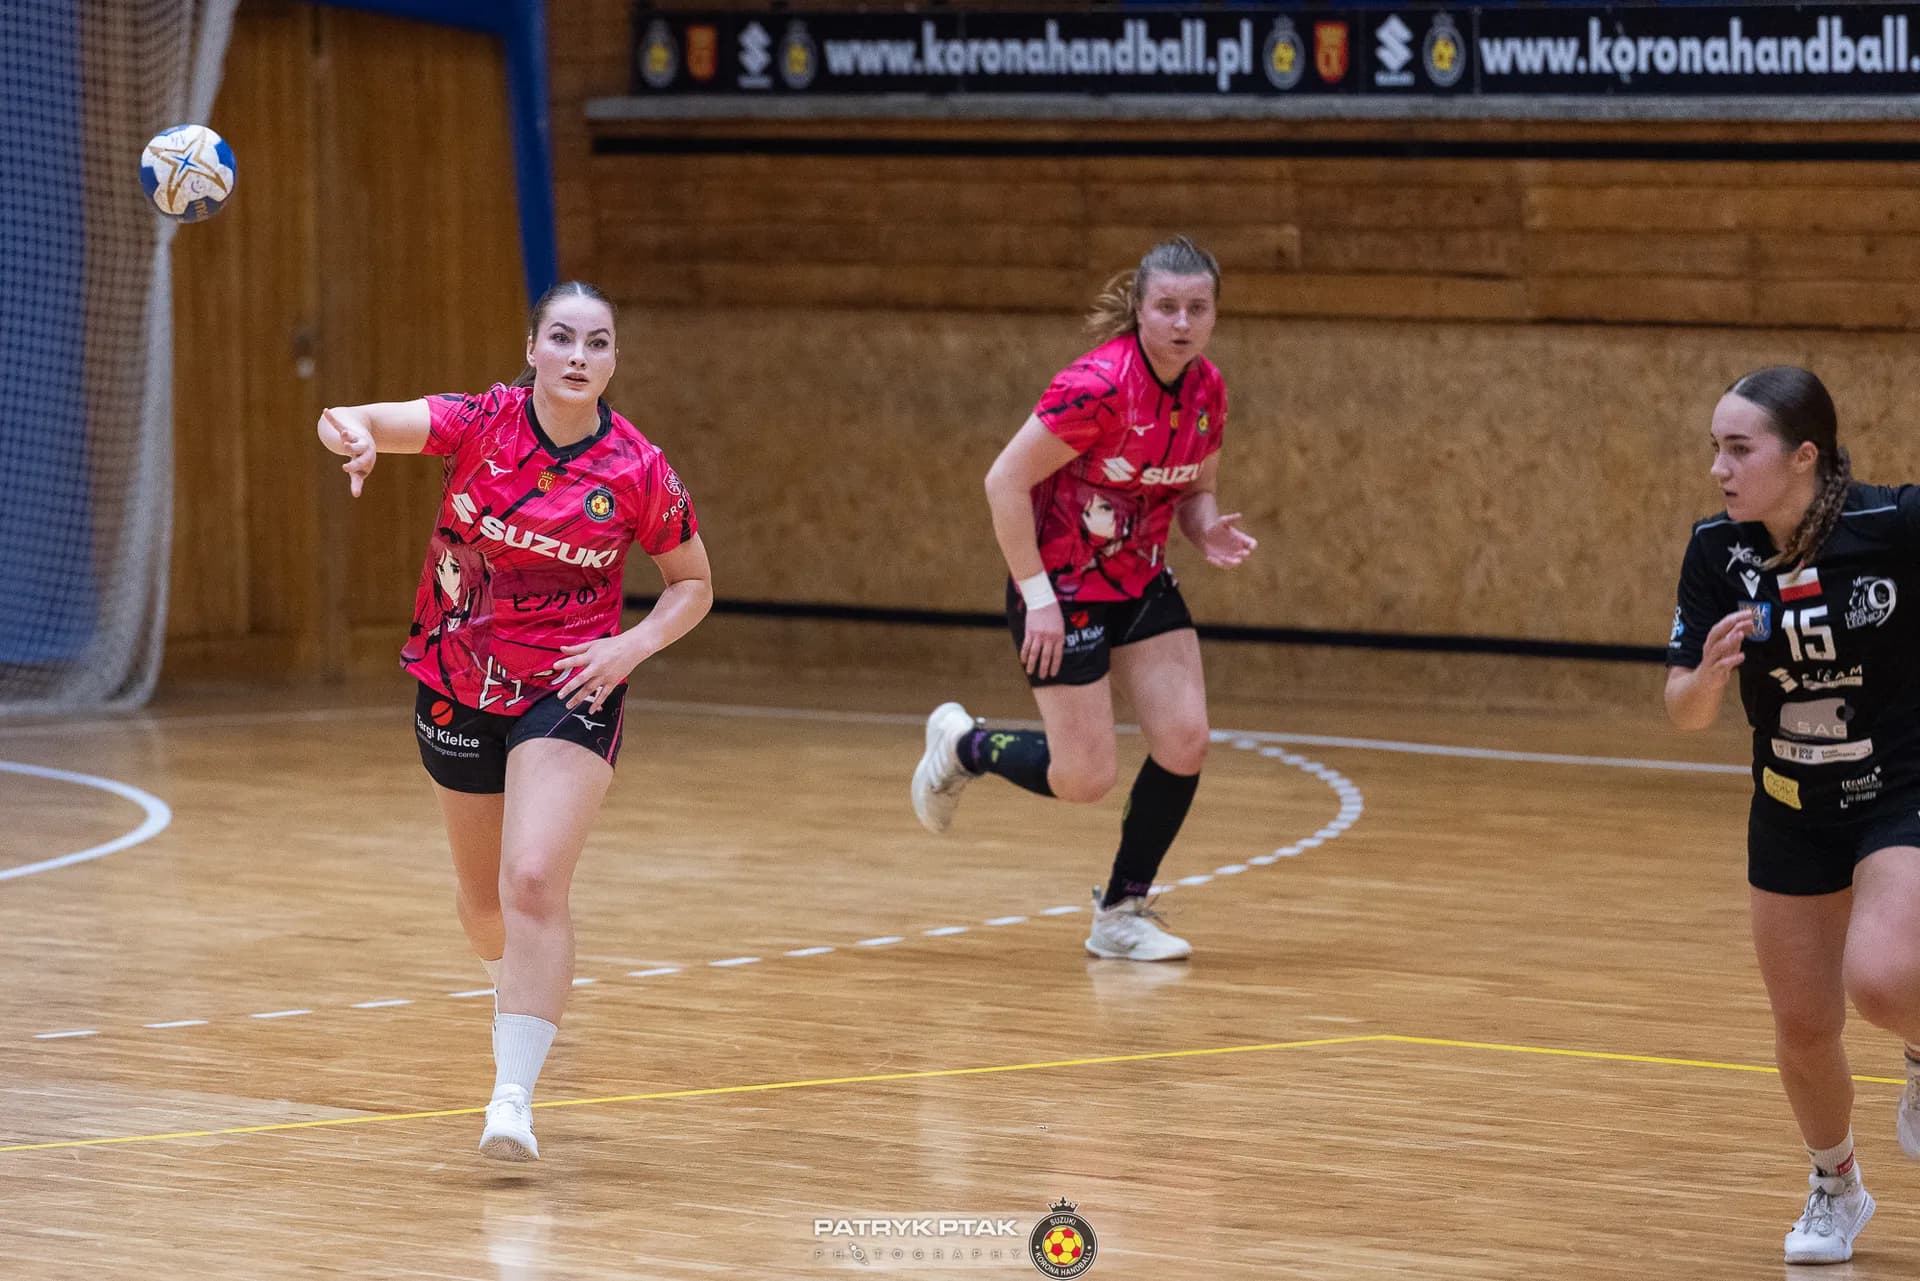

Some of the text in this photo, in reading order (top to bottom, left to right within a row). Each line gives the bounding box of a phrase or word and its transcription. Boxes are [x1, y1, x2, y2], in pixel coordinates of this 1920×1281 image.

[824, 19, 1253, 91] www.koronahandball.pl
[479, 515, 618, 569] SUZUKI
[1781, 604, 1837, 662] 15
[417, 713, 435, 739] Targi
[437, 729, 480, 748] Kielce
